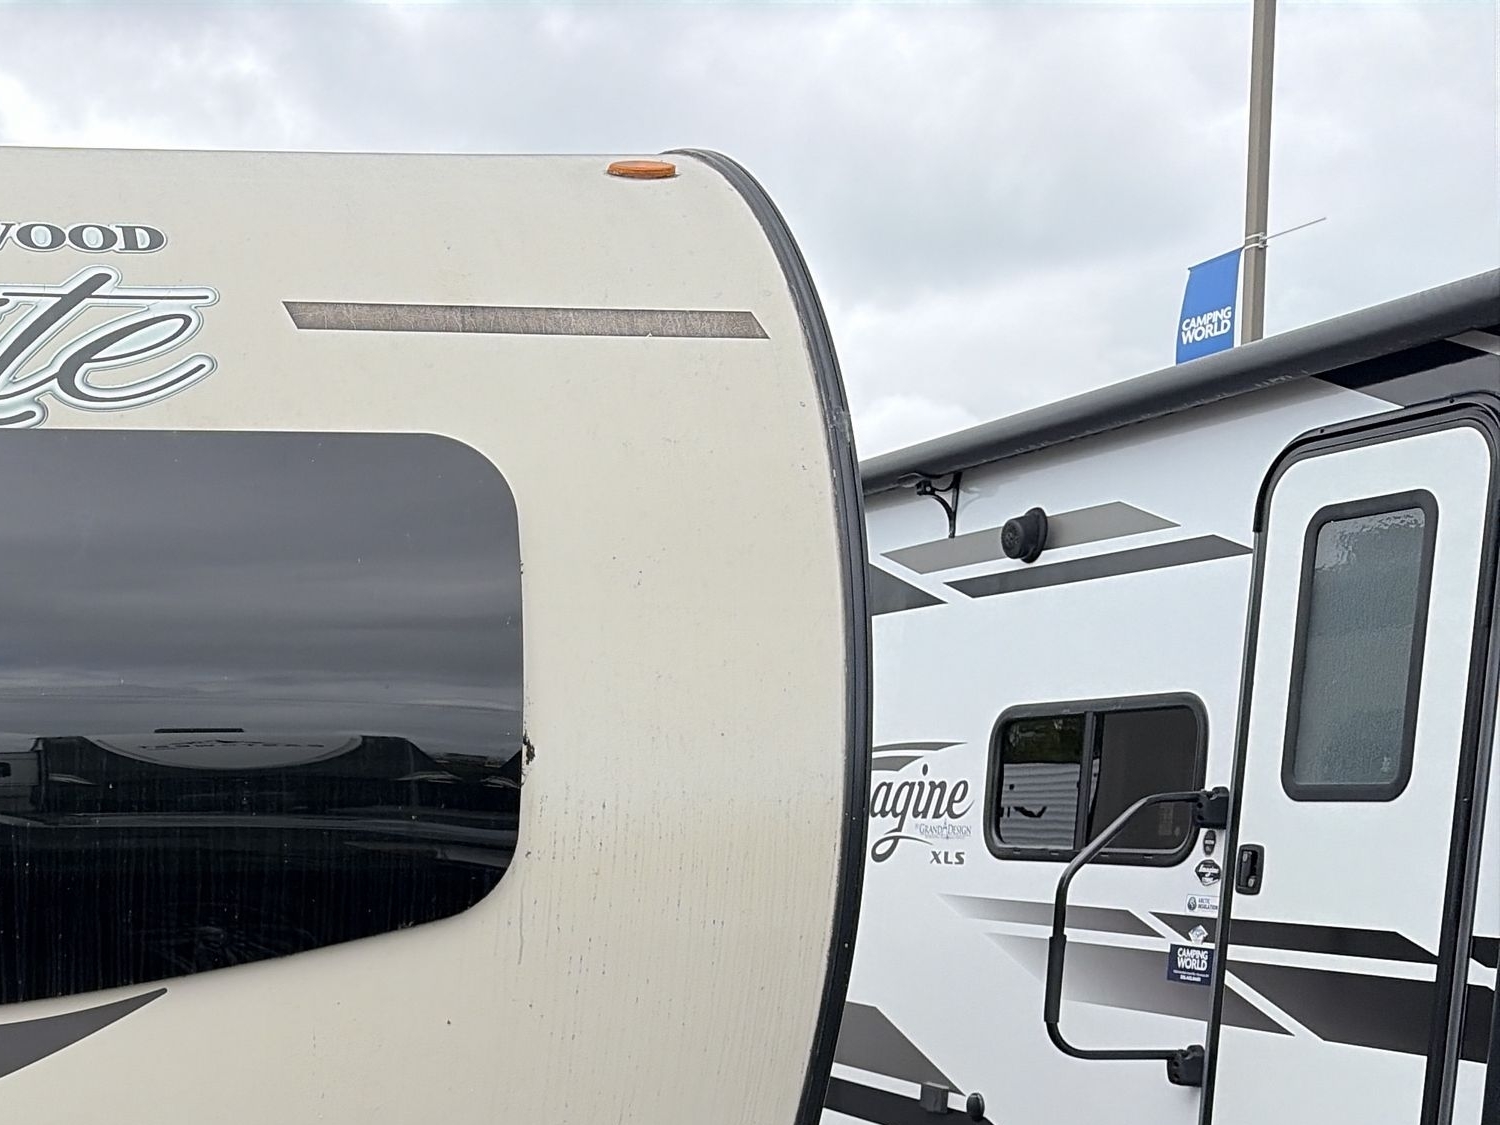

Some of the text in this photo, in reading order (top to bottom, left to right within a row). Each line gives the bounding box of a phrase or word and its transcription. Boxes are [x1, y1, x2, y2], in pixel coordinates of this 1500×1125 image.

[1181, 306, 1232, 332] CAMPING
[1181, 319, 1231, 345] WORLD
[930, 850, 965, 865] XLS
[1177, 947, 1209, 961] CAMPING
[1177, 956, 1208, 971] WORLD
